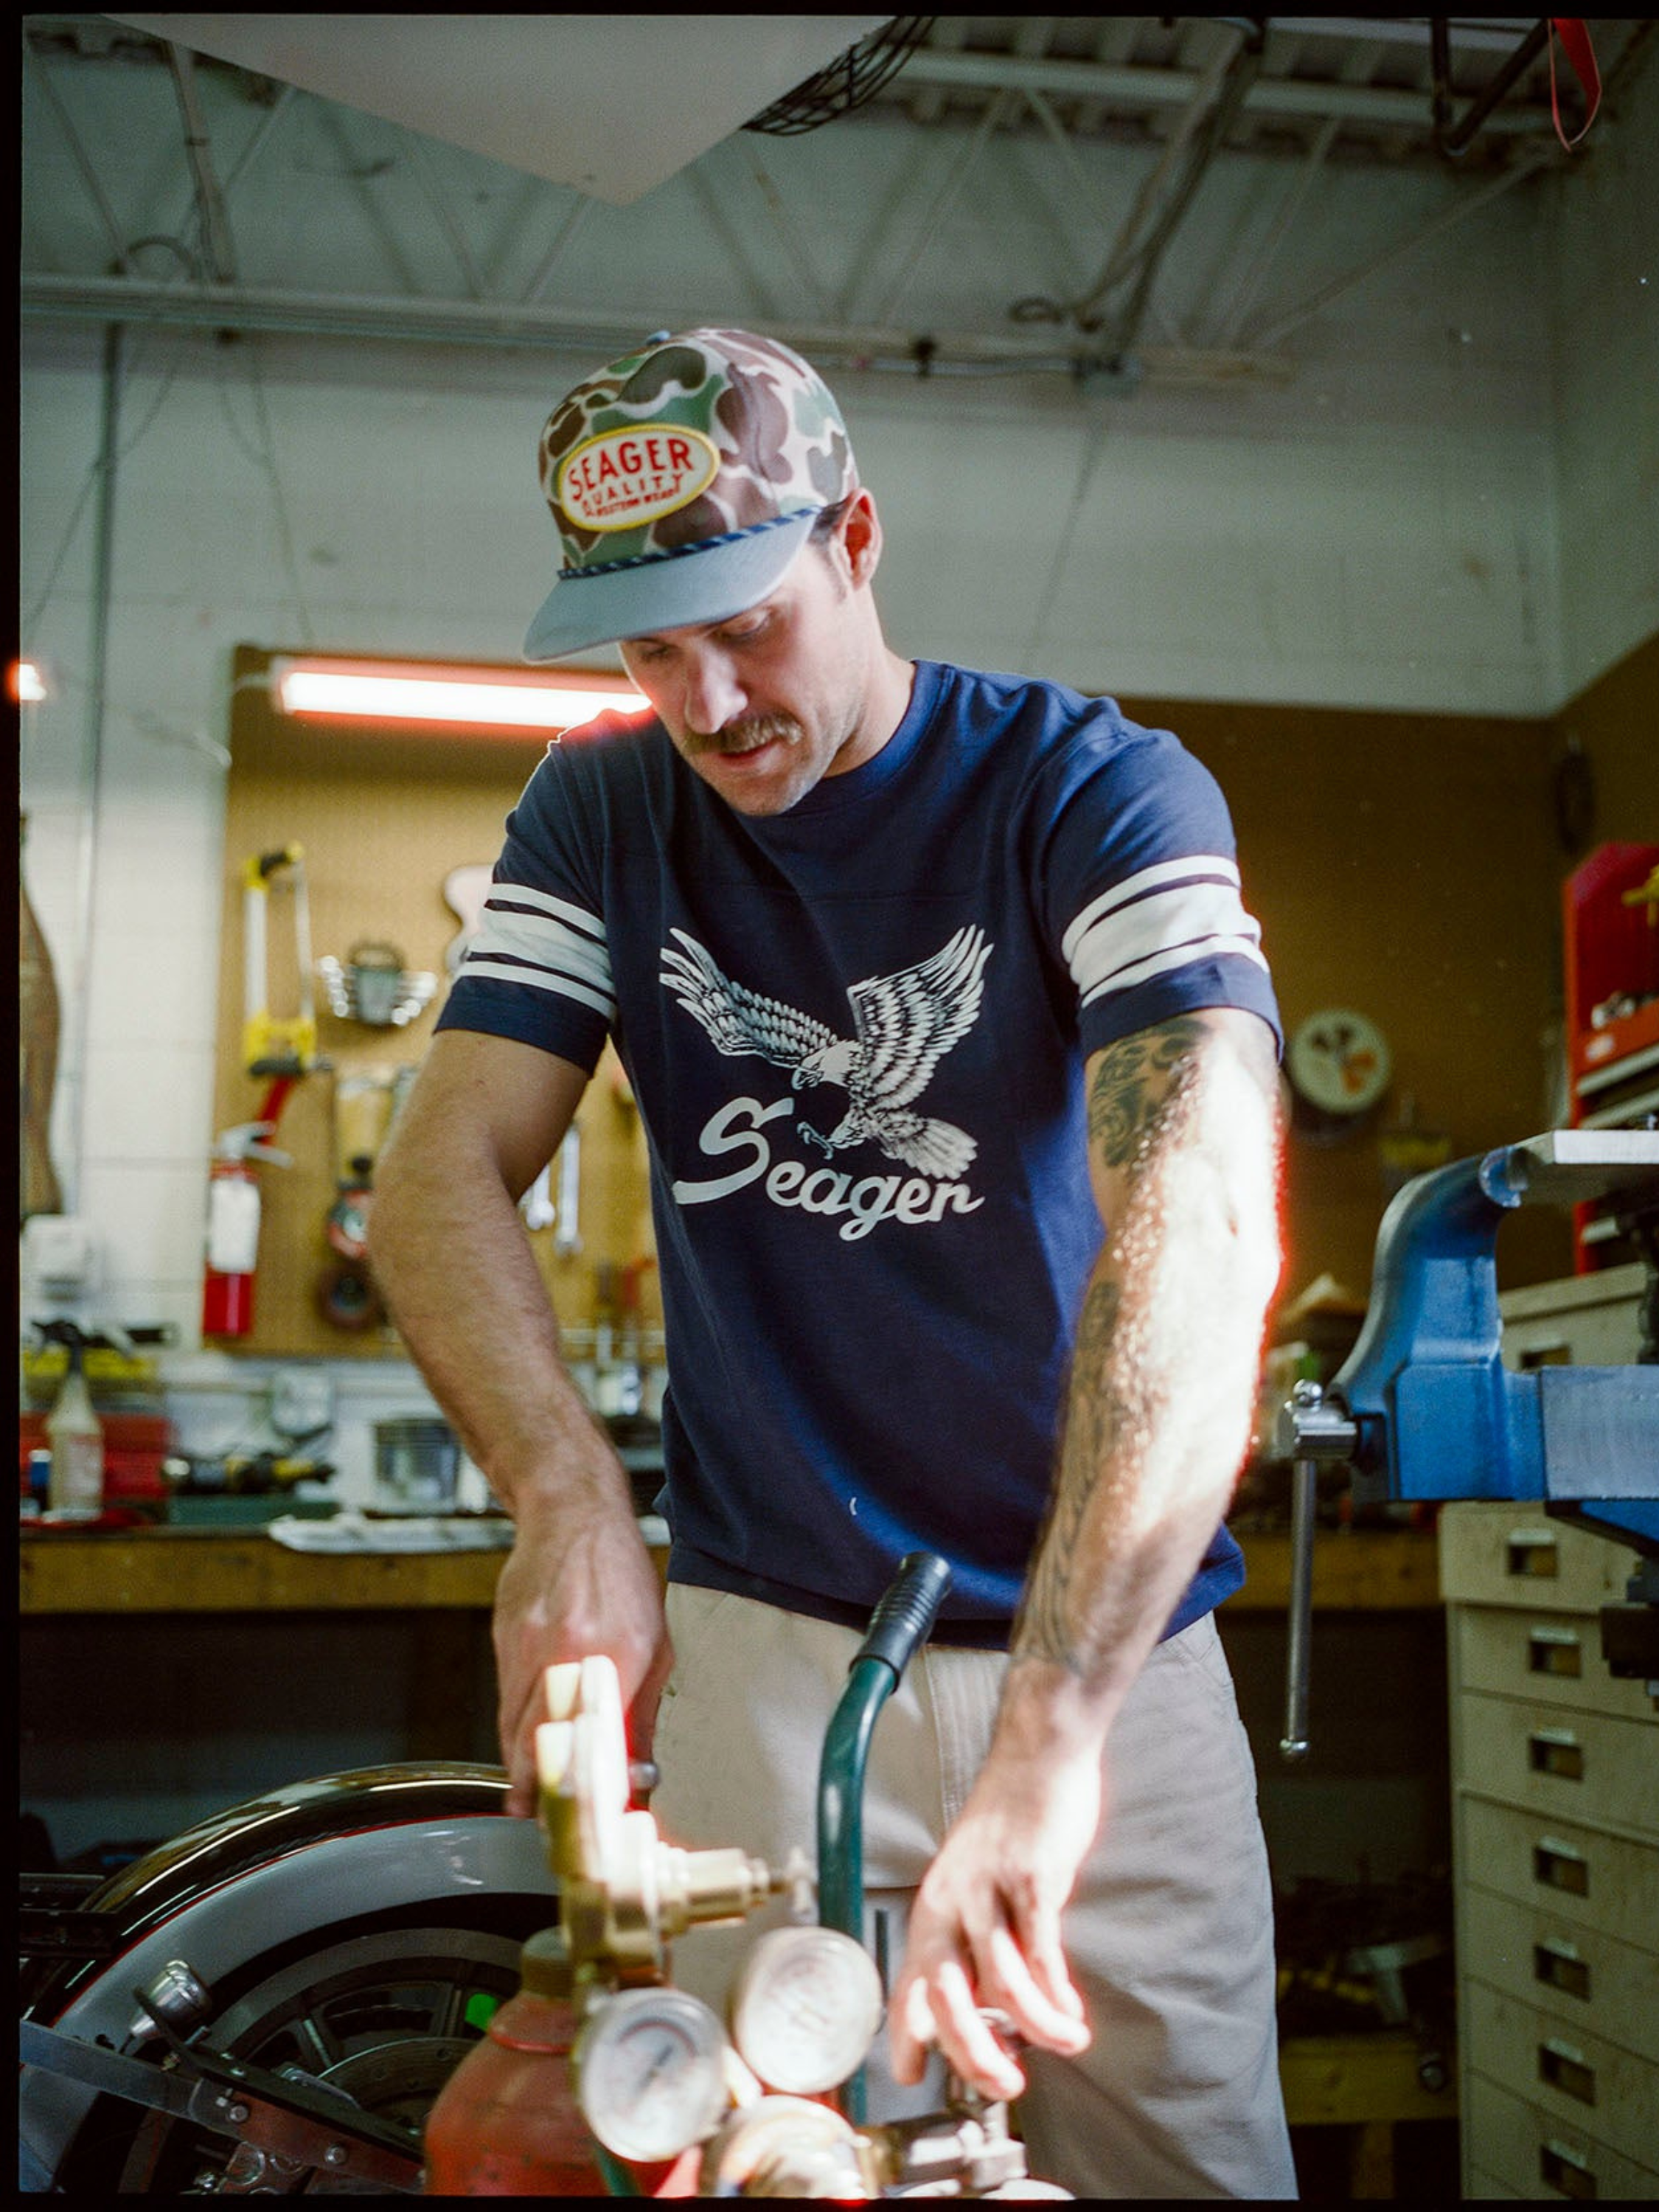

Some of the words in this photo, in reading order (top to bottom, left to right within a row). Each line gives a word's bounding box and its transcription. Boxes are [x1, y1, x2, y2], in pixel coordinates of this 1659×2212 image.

[568, 439, 693, 501] SEAGER
[582, 474, 684, 517] QUALITY
[672, 1097, 985, 1241] Seager
